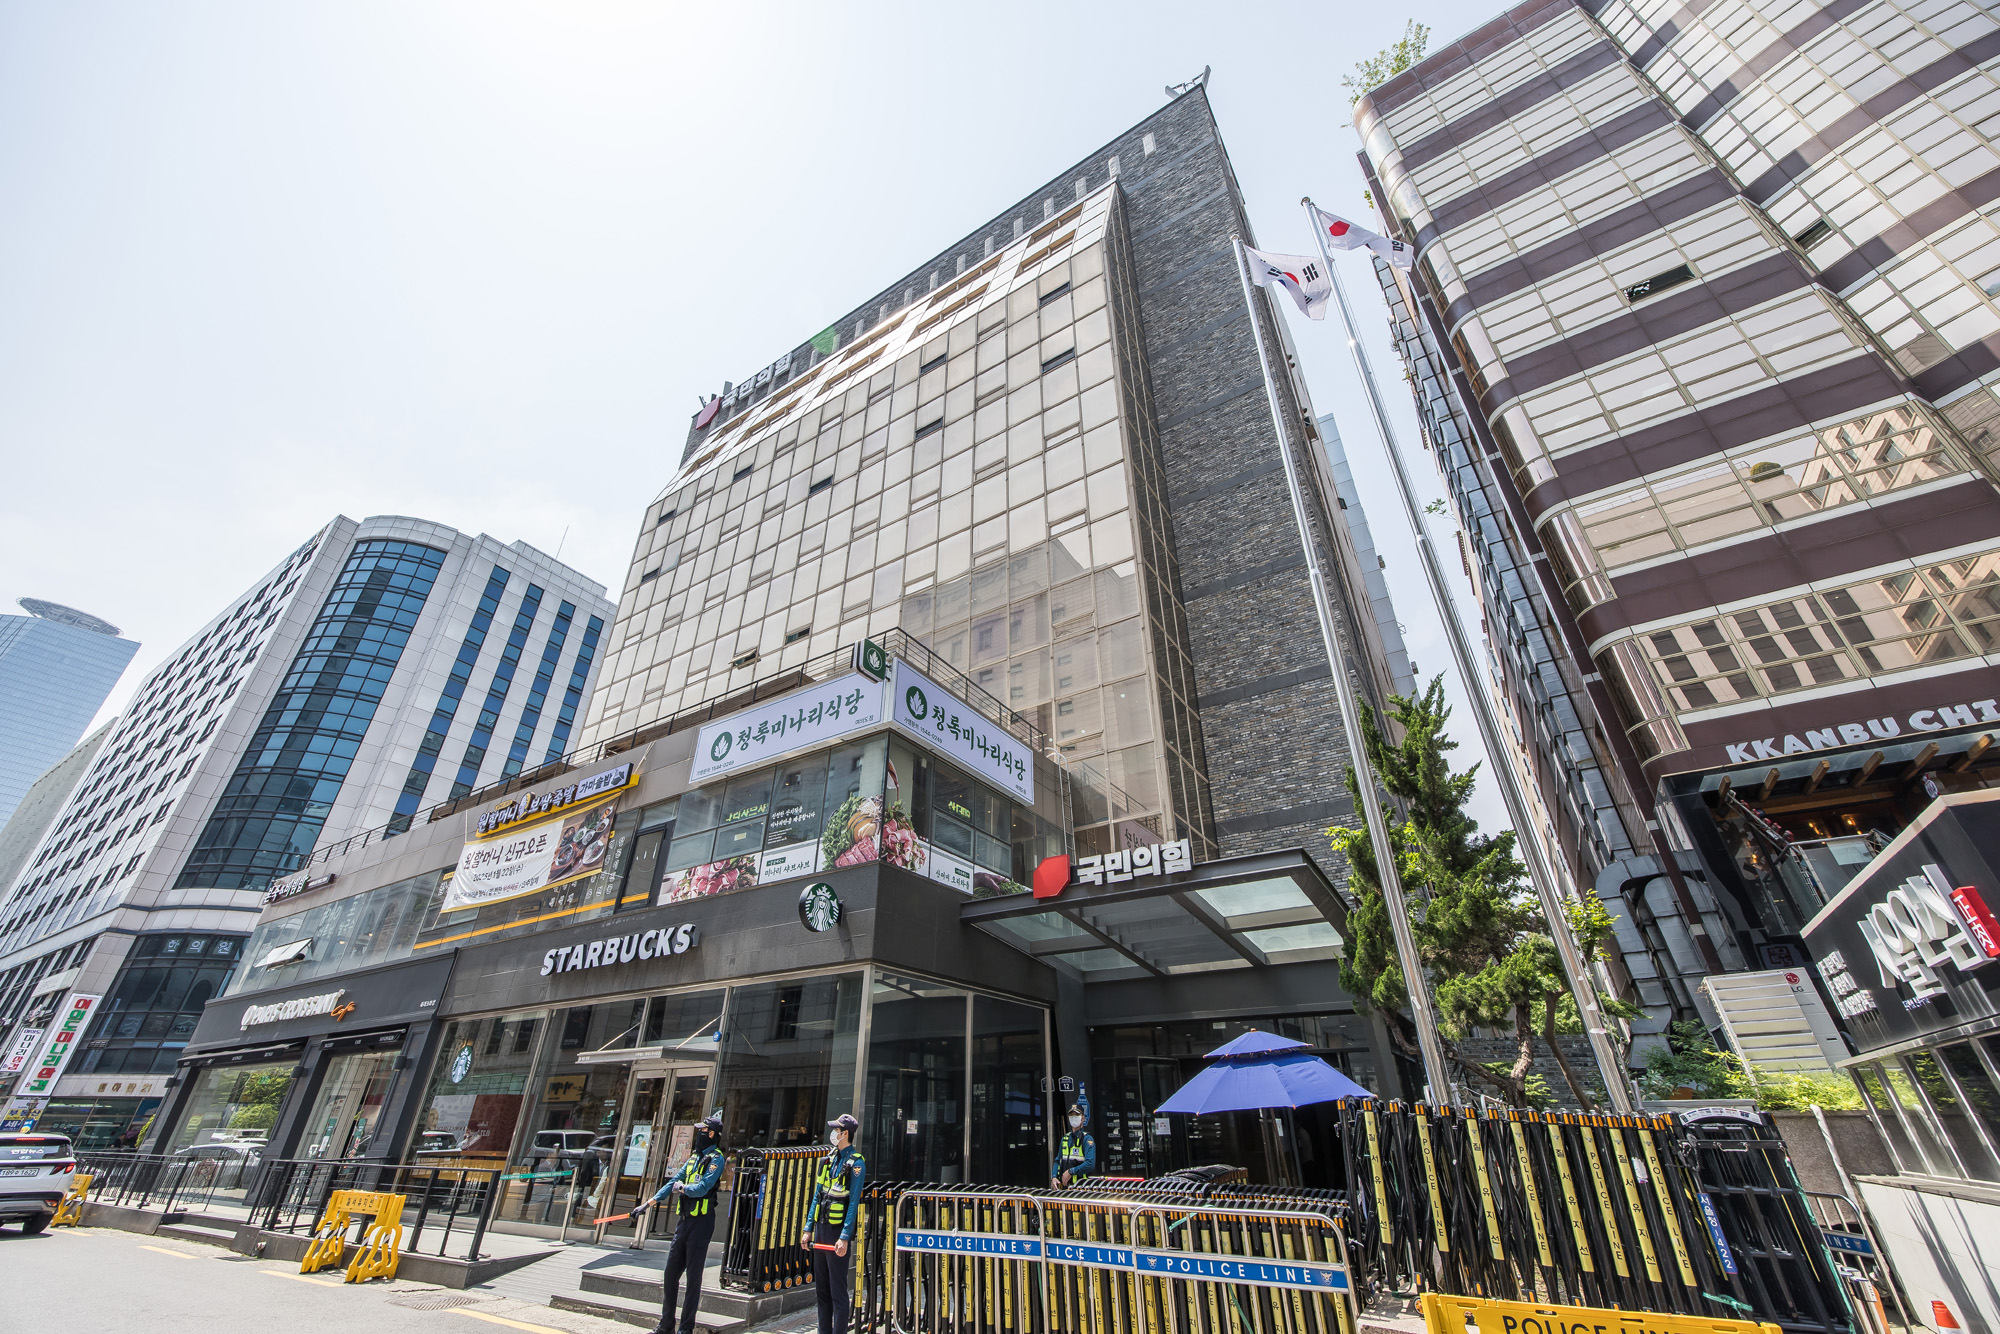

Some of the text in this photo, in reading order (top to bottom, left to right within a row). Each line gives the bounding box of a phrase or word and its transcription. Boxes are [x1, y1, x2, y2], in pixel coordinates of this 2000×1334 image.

[721, 352, 792, 409] 국민의힘
[736, 688, 865, 751] 청록미나리식당
[931, 704, 1026, 782] 청록미나리식당
[1725, 716, 1901, 765] KKANBU
[579, 772, 613, 794] 가마솥밥
[477, 801, 518, 833] 원할머니
[463, 833, 548, 870] 원할머니 신규오픈
[764, 865, 782, 877] 미나리
[783, 860, 810, 873] 샤브샤브
[1076, 838, 1192, 886] 국민의힘
[540, 923, 697, 976] STARBUCKS
[251, 993, 341, 1026] PARIS CROISSANT
[1791, 985, 1805, 993] LG
[10, 1147, 44, 1155] 연합뉴스
[1368, 1133, 1388, 1230] 질서유지선
[1422, 1138, 1445, 1237] POLICE LINE
[1472, 1142, 1501, 1245] 질서유지선
[1518, 1146, 1547, 1251] POLICE LINE
[1555, 1148, 1590, 1256] 질서유지선
[1590, 1152, 1623, 1260] POLICE LINE
[1617, 1154, 1657, 1266] 질서유지선
[1650, 1156, 1691, 1269] POLICE LINE
[1700, 1195, 1733, 1269] 서울청 1422
[917, 1235, 1017, 1253] POLICE LINE
[1046, 1244, 1134, 1266] LICE LIN
[1826, 1234, 1852, 1250] INE
[1166, 1257, 1312, 1283] POLICE LINE
